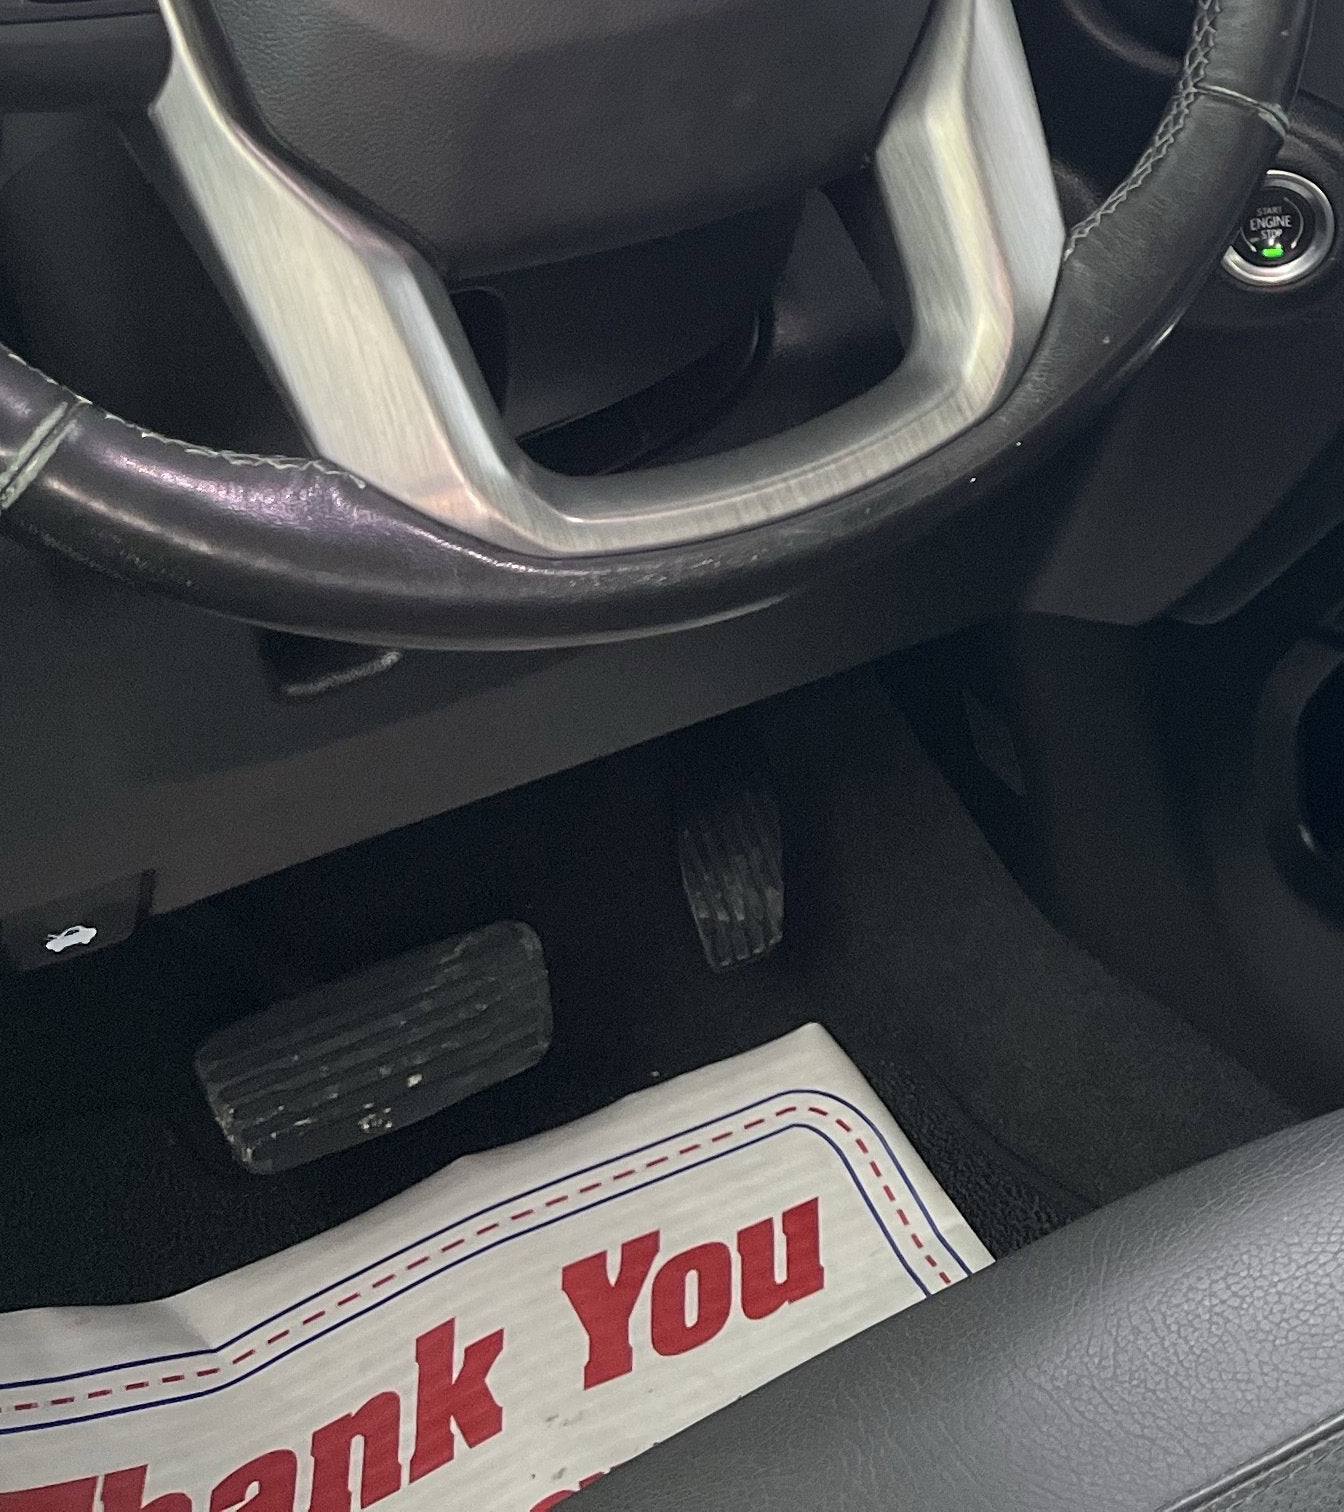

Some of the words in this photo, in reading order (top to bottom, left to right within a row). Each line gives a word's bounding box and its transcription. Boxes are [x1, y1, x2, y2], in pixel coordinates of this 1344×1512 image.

[1256, 205, 1283, 216] START
[1250, 215, 1293, 232] ENGINE
[1261, 228, 1283, 239] STOP
[561, 1196, 826, 1391] You
